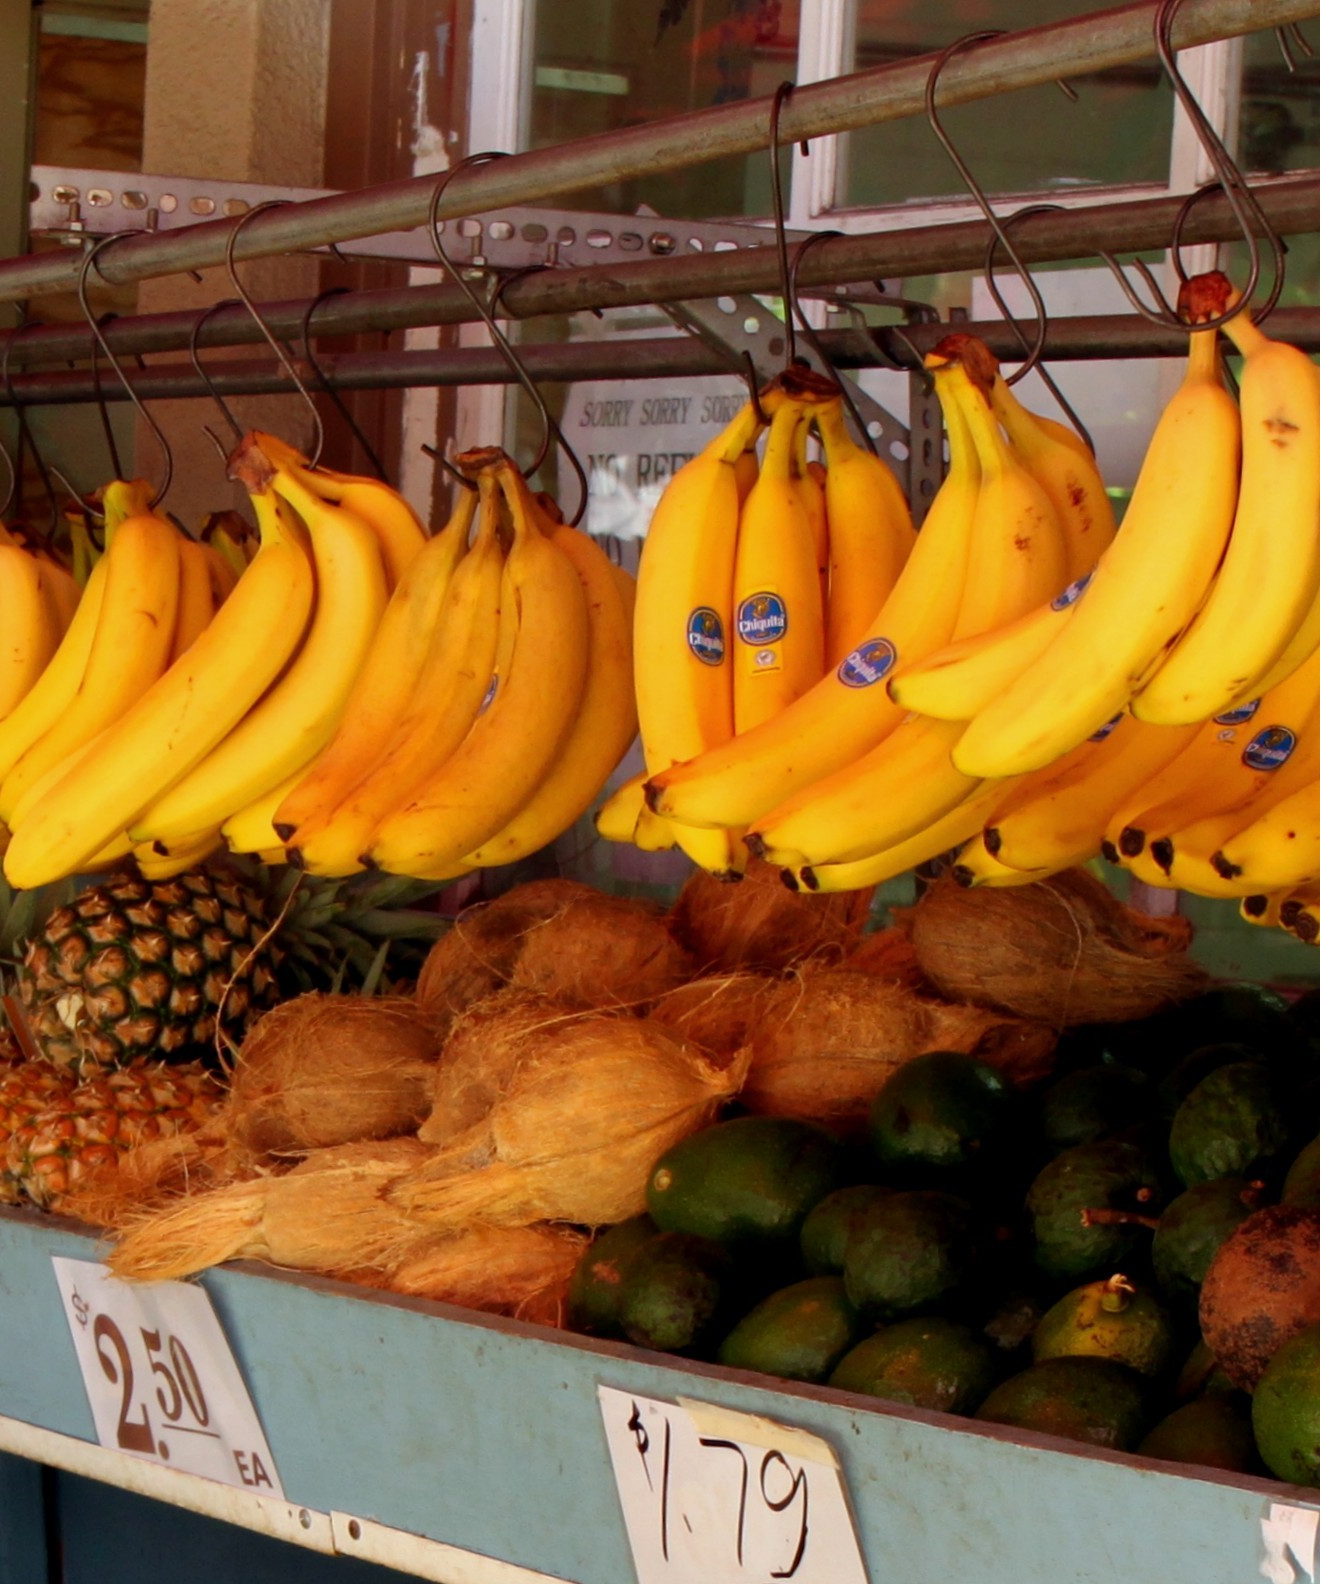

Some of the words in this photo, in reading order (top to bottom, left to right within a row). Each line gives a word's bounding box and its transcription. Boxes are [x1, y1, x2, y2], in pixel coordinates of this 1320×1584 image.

[580, 399, 632, 427] SORRY
[640, 397, 693, 426] SORRY
[739, 614, 785, 634] Chiquita
[233, 1450, 273, 1489] EA
